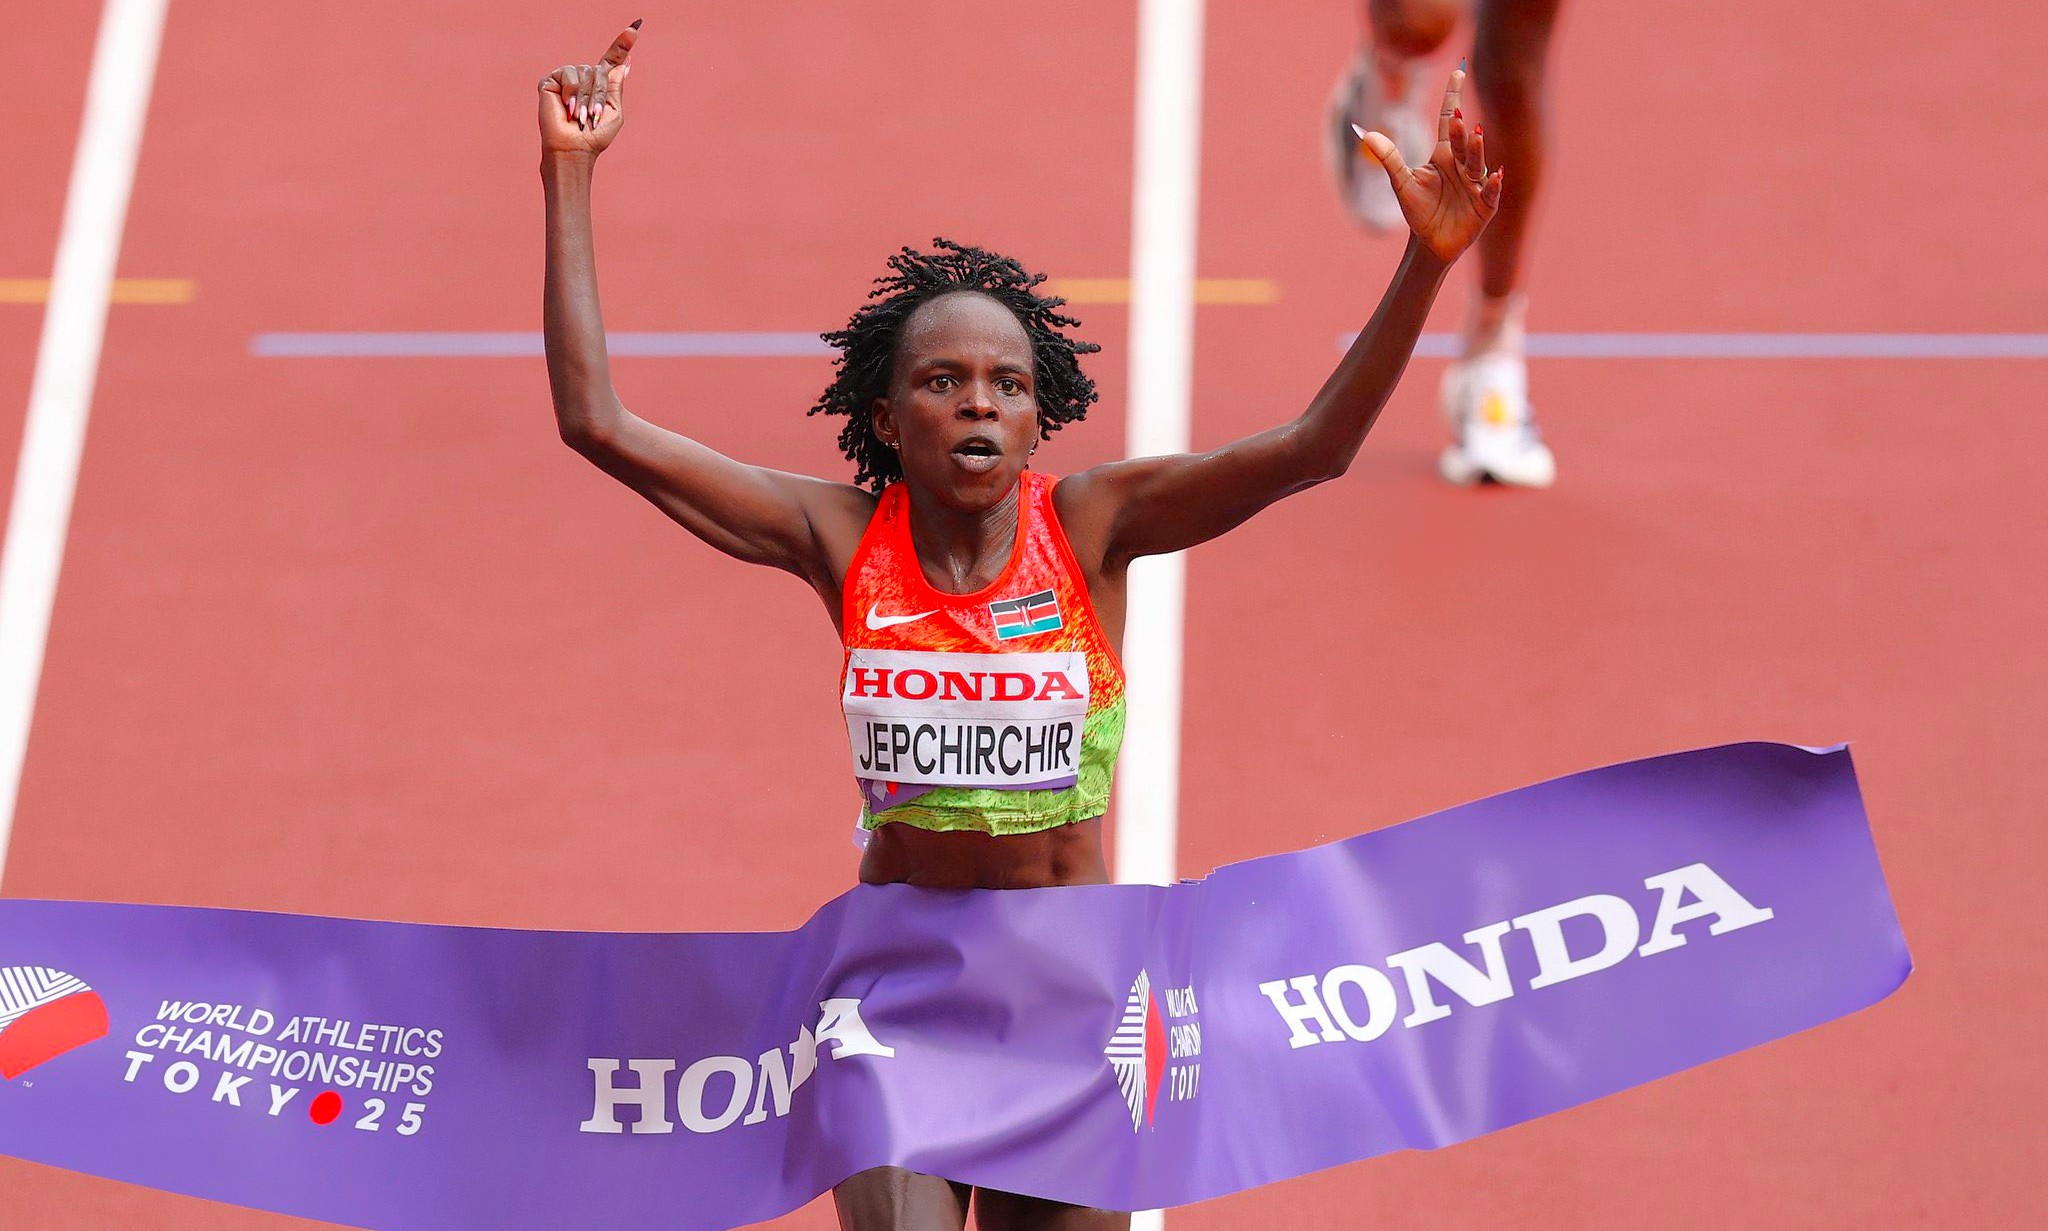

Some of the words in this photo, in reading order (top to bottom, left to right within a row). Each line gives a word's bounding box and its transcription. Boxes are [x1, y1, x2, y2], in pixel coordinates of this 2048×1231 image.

[850, 666, 1084, 702] HONDA
[859, 721, 1074, 776] JEPCHIRCHIR
[1258, 862, 1775, 1050] HONDA
[155, 1000, 275, 1036] WORLD
[275, 1016, 443, 1058] ATHLETICS
[135, 1024, 436, 1096] CHAMPIONSHIPS
[354, 1098, 427, 1136] 25
